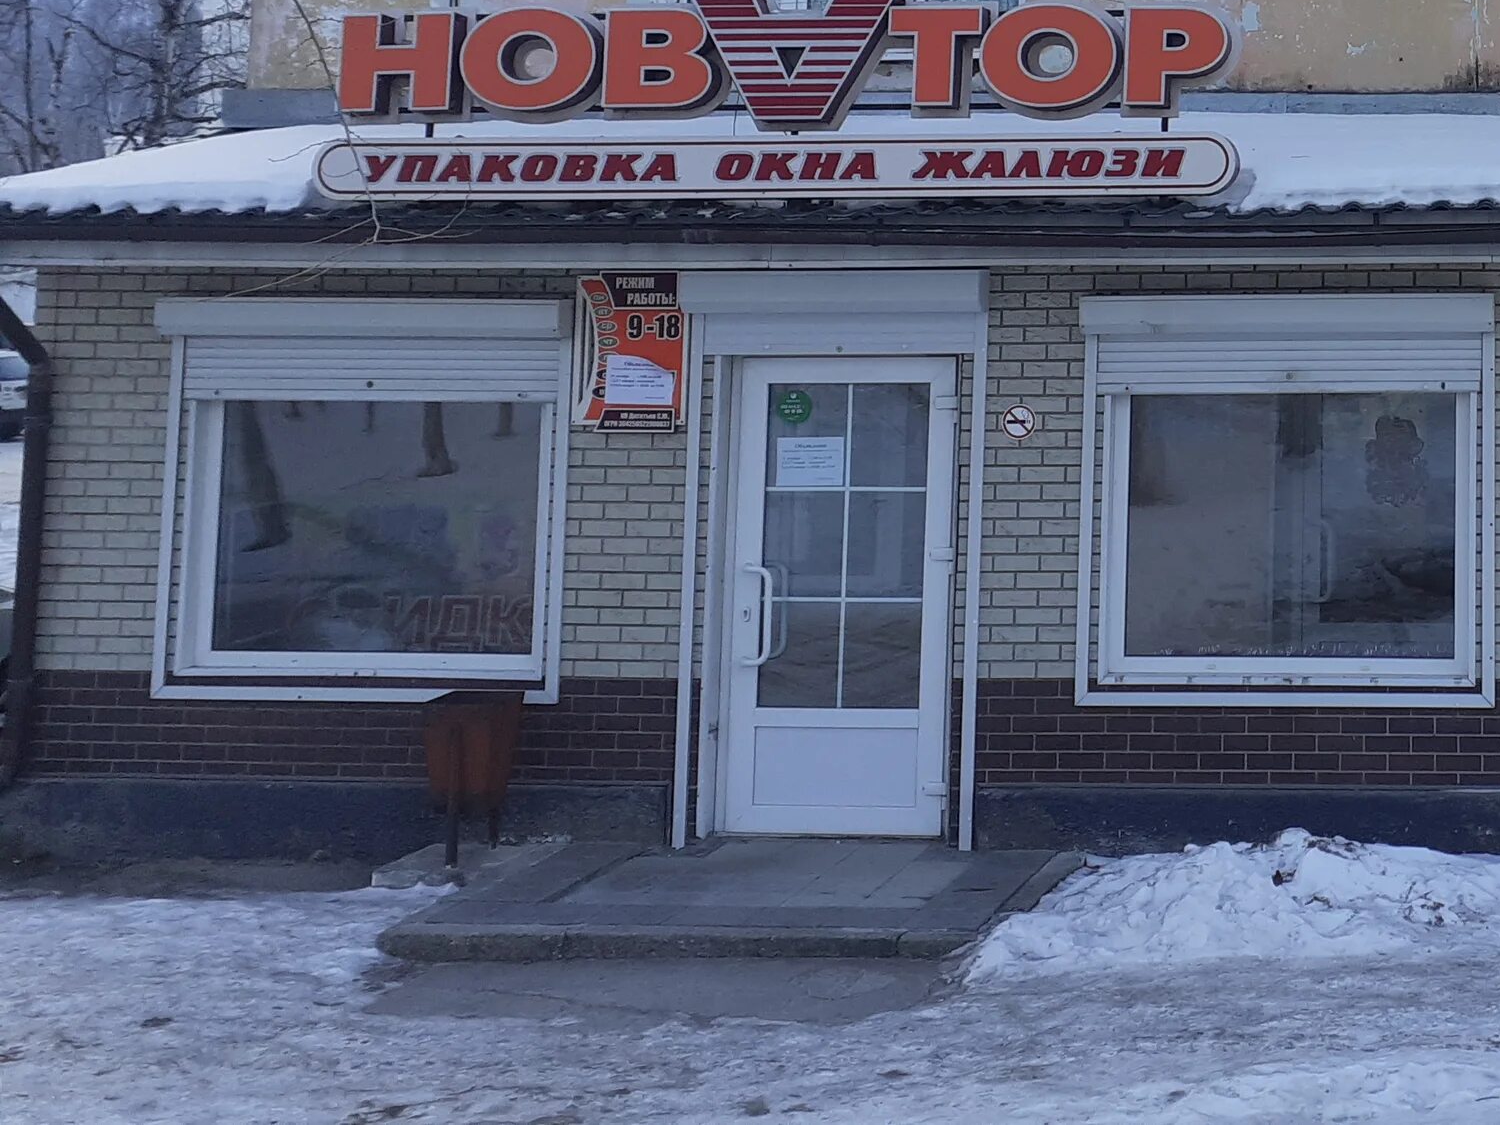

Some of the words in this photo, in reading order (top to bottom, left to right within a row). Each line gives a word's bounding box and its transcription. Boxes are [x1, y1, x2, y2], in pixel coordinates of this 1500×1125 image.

[363, 150, 679, 184] УПАКОВКА
[715, 149, 879, 182] ОКНА
[911, 147, 1185, 181] ЖАЛЮЗИ
[615, 277, 655, 289] РЕЖИМ
[626, 292, 676, 306] РАБОТЫ:
[627, 313, 682, 340] 9-18
